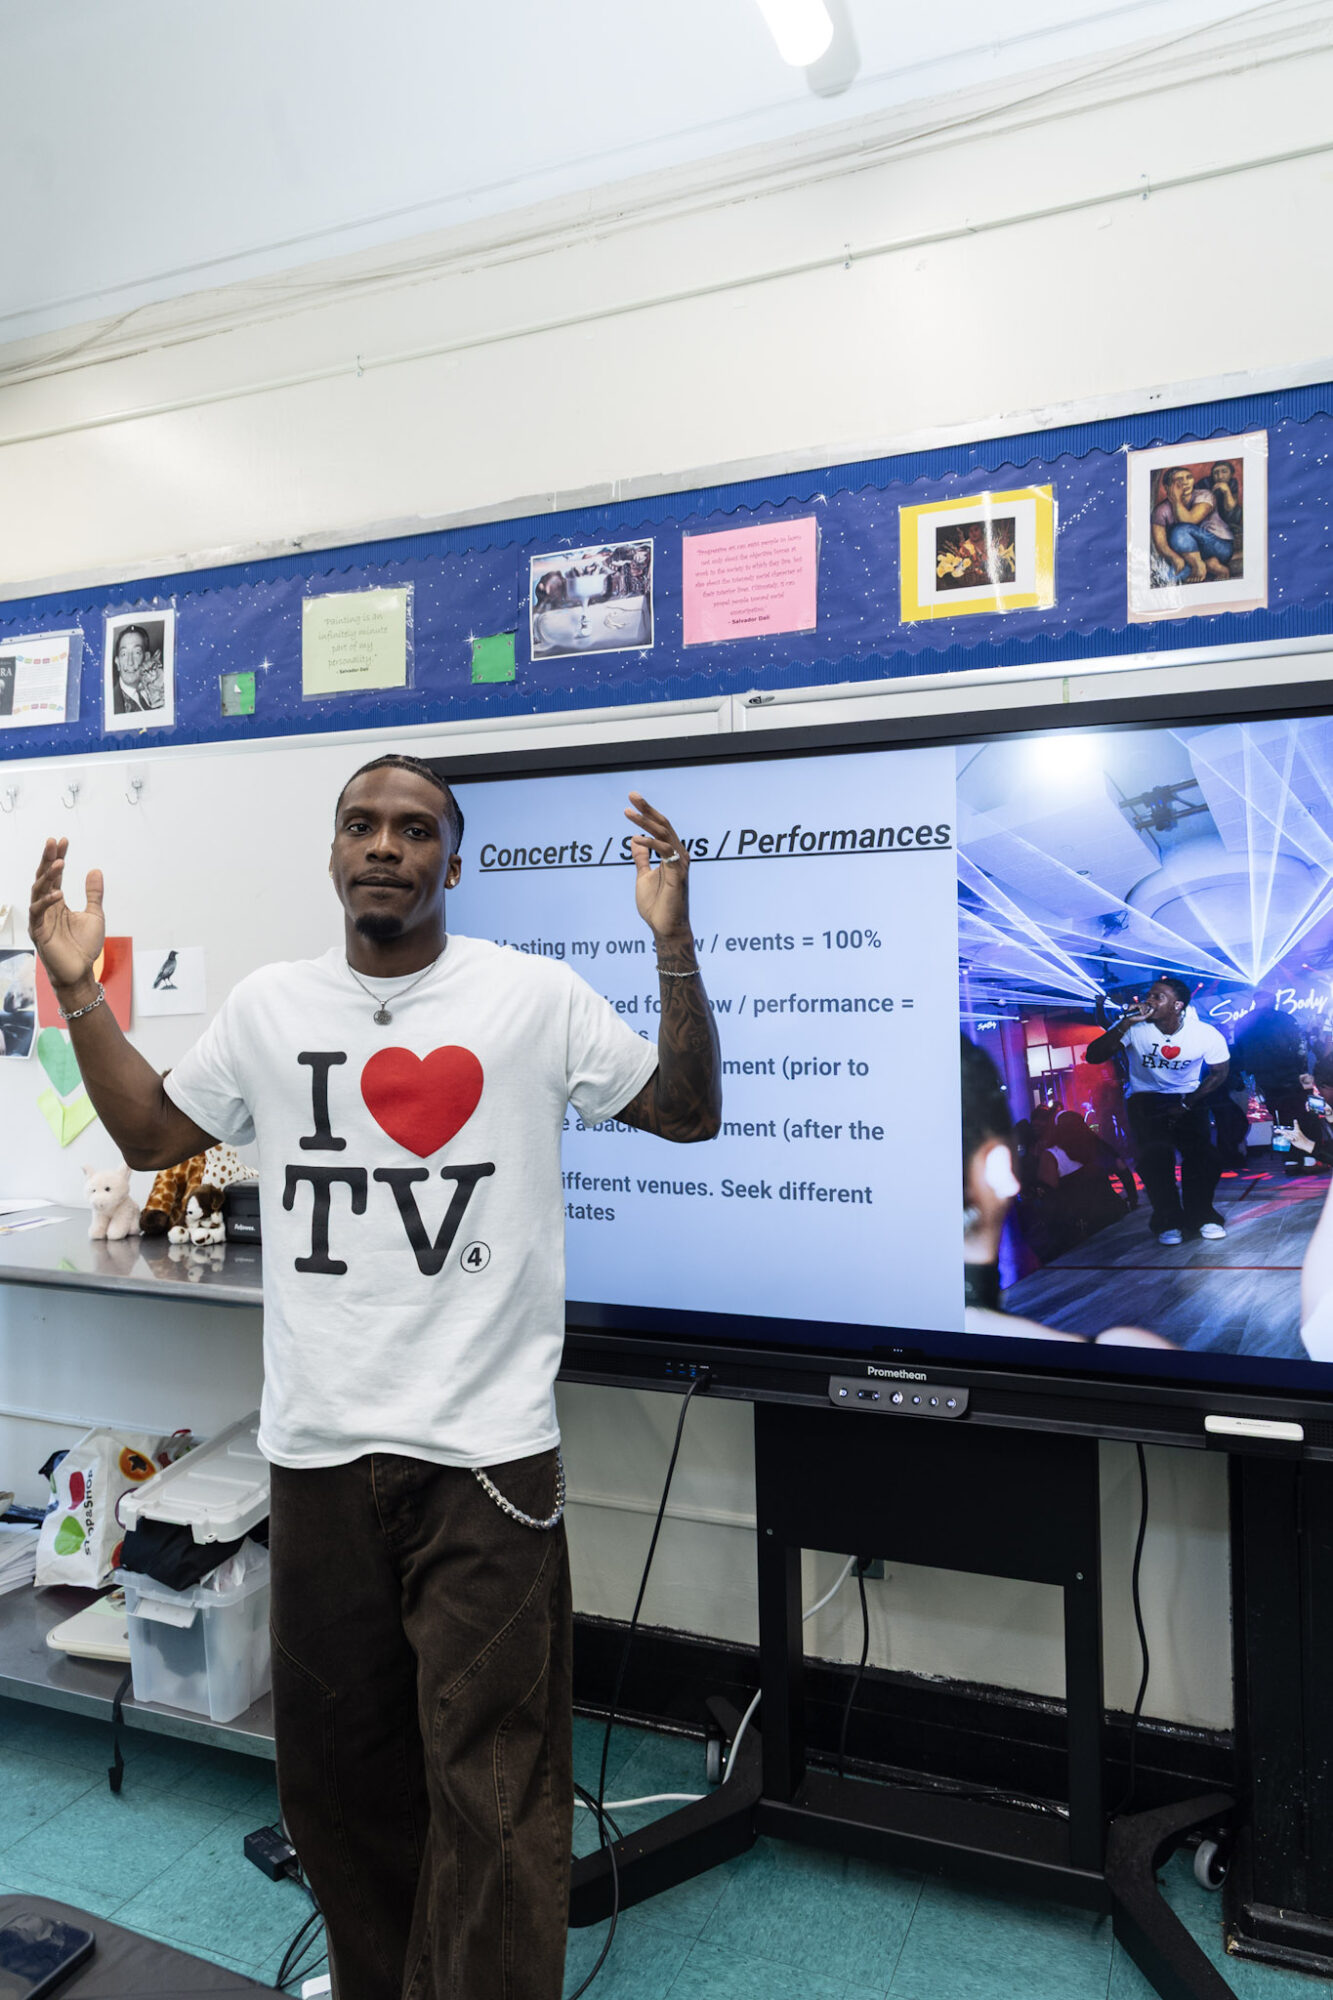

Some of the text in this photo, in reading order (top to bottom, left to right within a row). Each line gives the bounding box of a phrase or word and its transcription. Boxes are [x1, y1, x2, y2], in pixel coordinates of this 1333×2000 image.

[480, 840, 593, 868] Concerts
[738, 824, 951, 854] Performances
[571, 940, 600, 959] my
[606, 939, 645, 954] own
[725, 933, 795, 951] events
[822, 929, 882, 949] 100%
[754, 993, 894, 1017] performance
[1275, 988, 1328, 1014] Body
[783, 1055, 841, 1080] (prior
[847, 1058, 869, 1076] to
[297, 1051, 347, 1152] I
[783, 1118, 842, 1143] (after
[849, 1120, 884, 1140] the
[562, 1171, 873, 1204] ifferent venues. Seek different
[282, 1162, 496, 1276] TV
[467, 1247, 482, 1267] 4
[867, 1365, 927, 1381] Promethean
